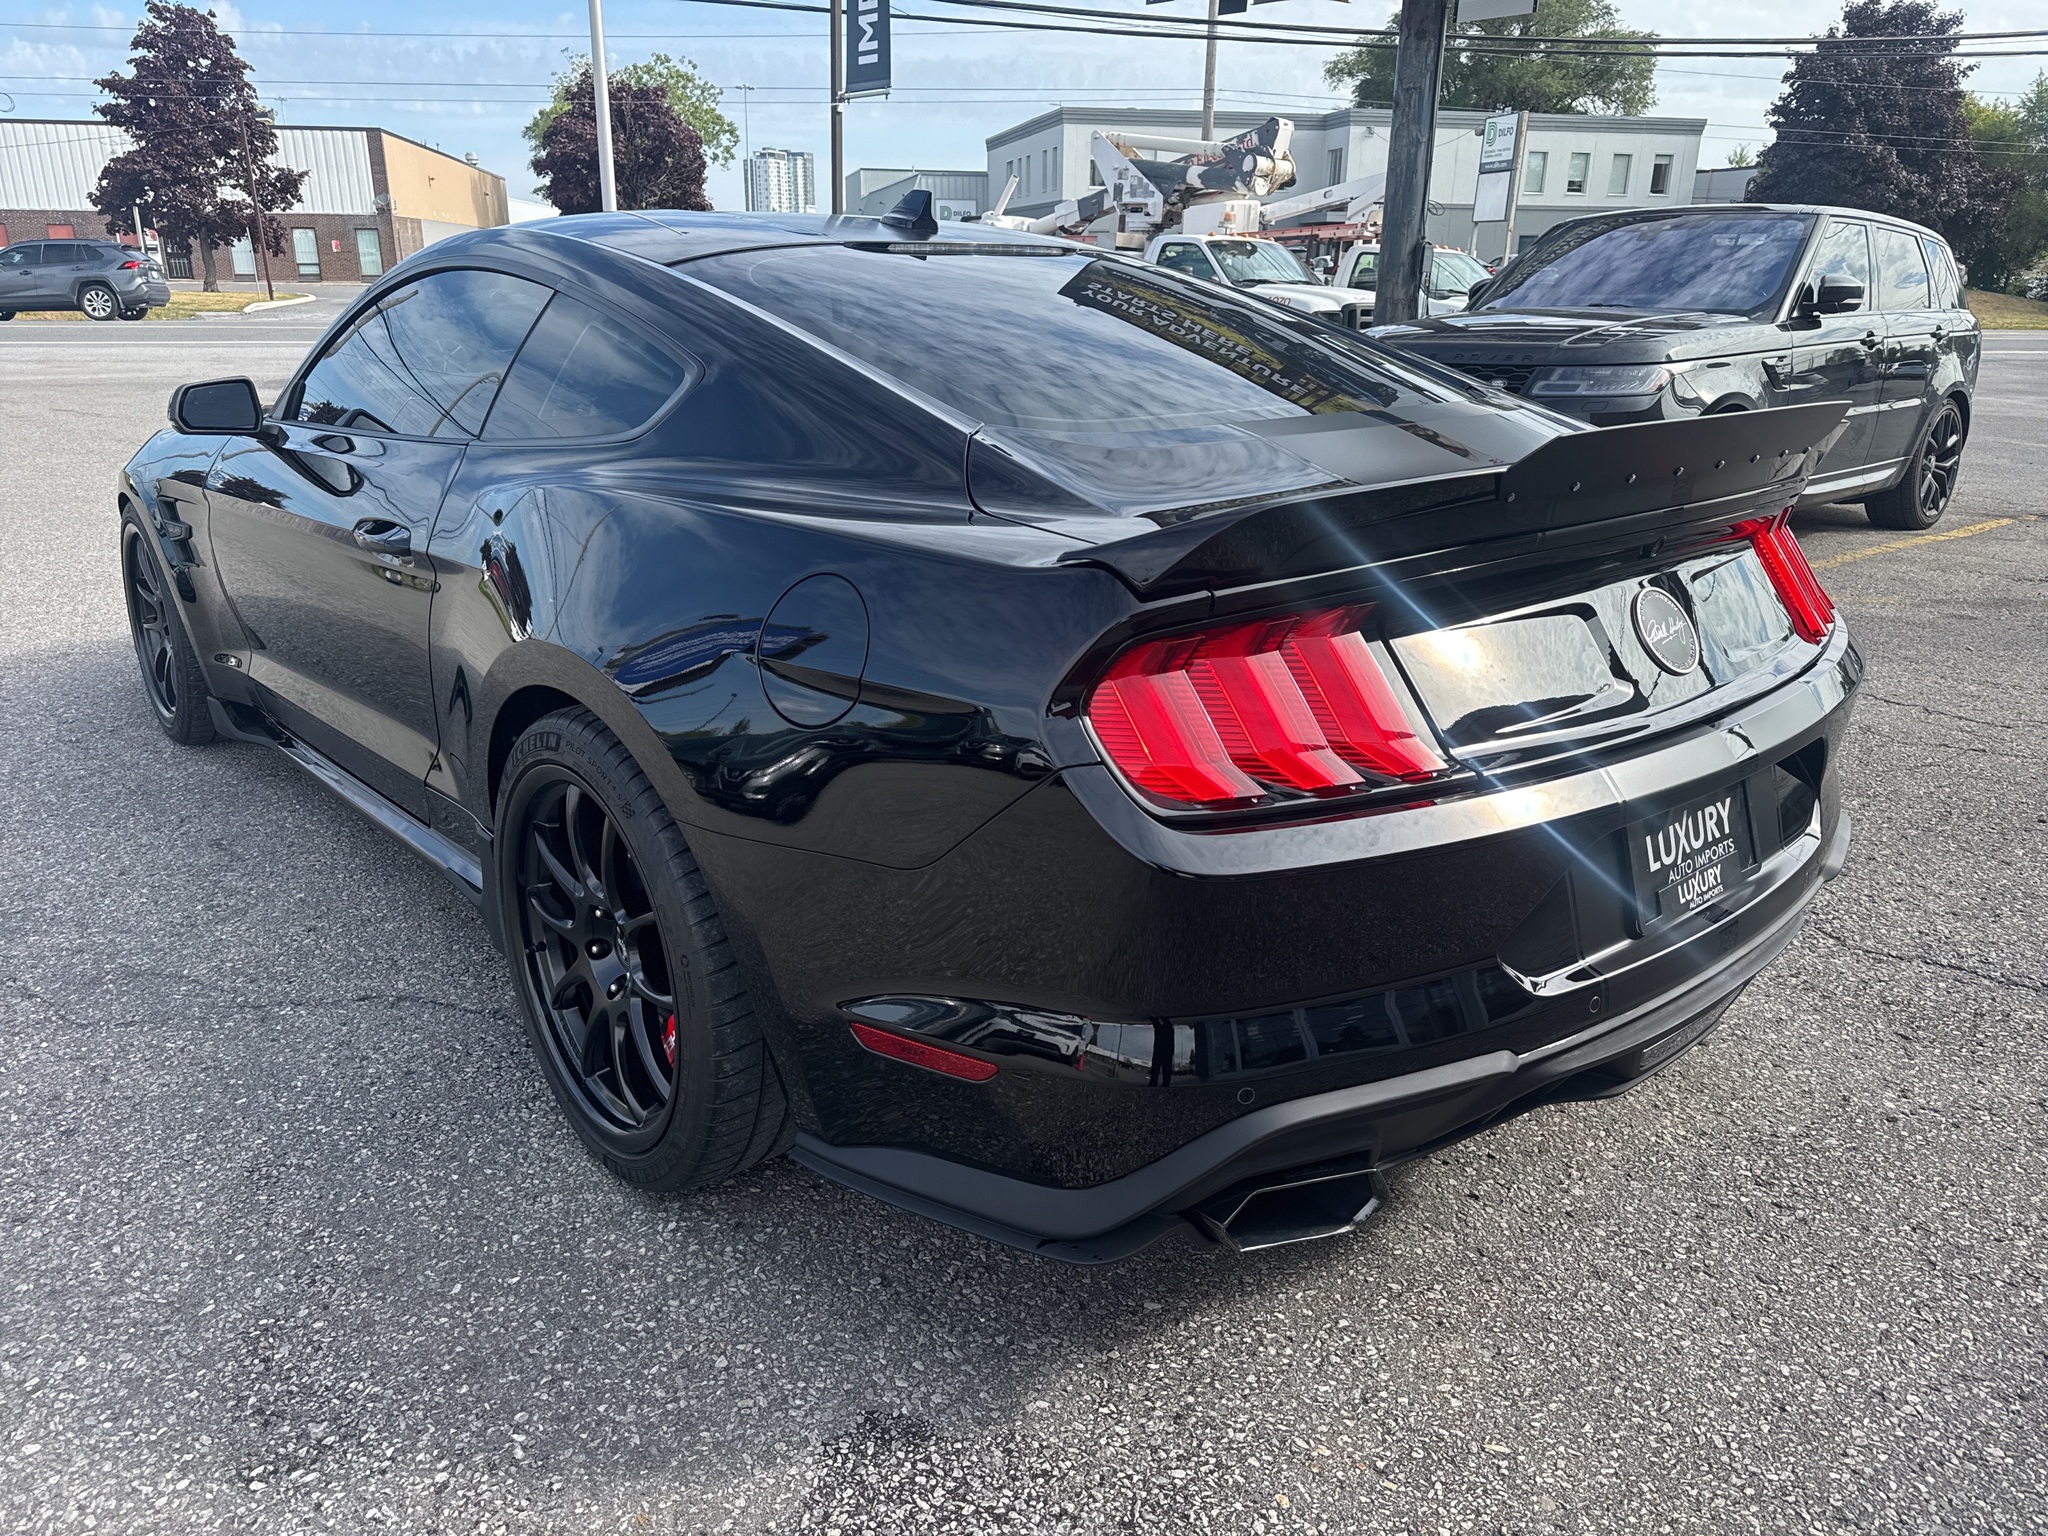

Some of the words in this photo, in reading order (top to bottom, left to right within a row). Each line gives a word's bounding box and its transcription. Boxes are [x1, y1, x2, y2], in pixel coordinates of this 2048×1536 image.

[1497, 126, 1515, 138] DILFO
[1452, 353, 1535, 362] ROVER
[565, 740, 586, 758] PILOT
[586, 756, 612, 786] SPORT
[1645, 797, 1732, 873] LUXURY
[1668, 859, 1693, 884] AUTO
[1694, 838, 1735, 868] IMPORTS
[1677, 863, 1722, 904] LUXURY
[1689, 897, 1703, 909] AUTO
[1703, 884, 1724, 901] IMPORTS
